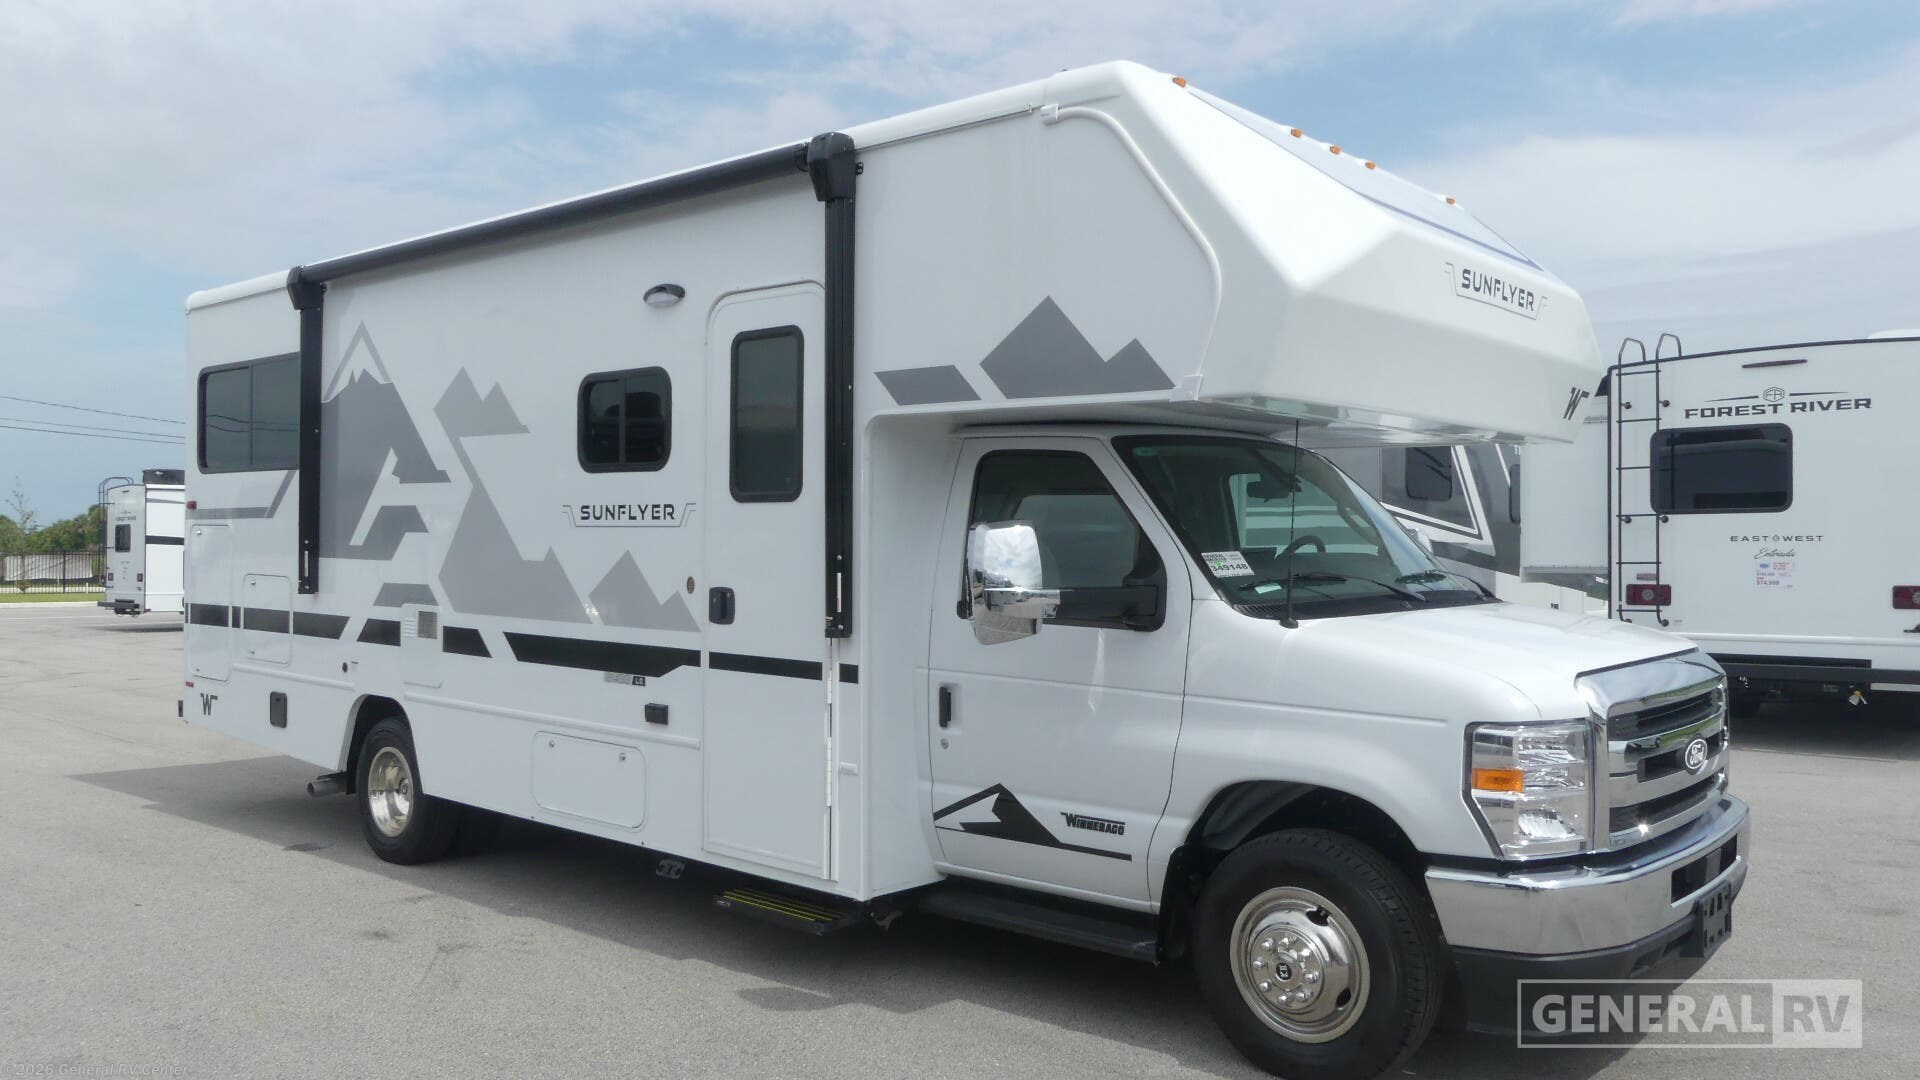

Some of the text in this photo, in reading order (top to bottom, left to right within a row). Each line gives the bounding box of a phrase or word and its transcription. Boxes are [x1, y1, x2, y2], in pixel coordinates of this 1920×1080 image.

[1461, 268, 1535, 312] SUNFLYER
[1684, 398, 1872, 419] FOREST RIVER
[580, 504, 675, 520] SUNFLYER
